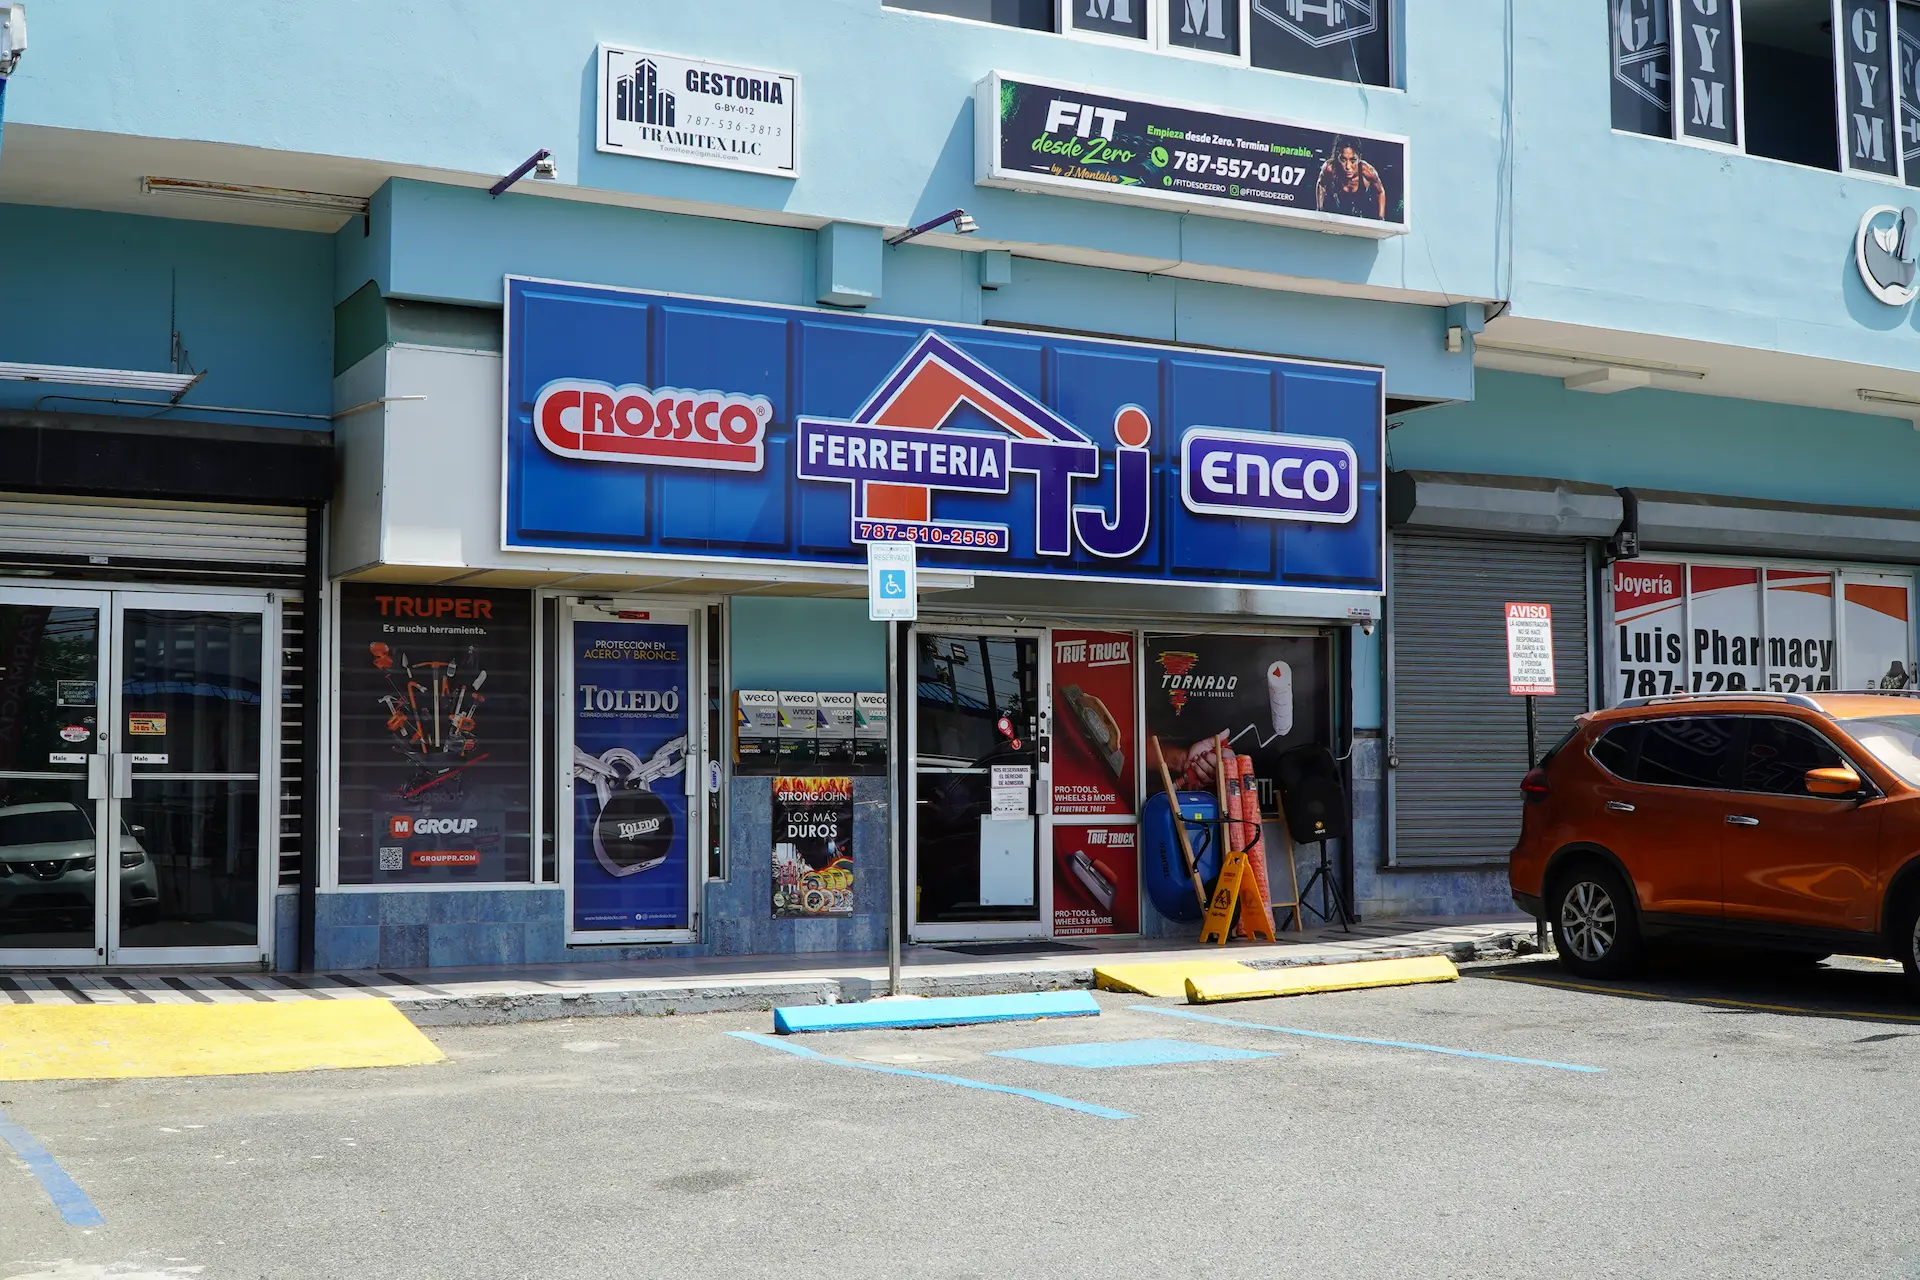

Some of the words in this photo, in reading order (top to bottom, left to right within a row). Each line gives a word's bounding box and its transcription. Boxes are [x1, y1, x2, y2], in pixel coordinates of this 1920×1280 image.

[685, 69, 783, 104] GESTORIA
[714, 102, 755, 116] G-BY-012
[686, 114, 782, 137] 787-536-3813
[1044, 99, 1127, 142] FIT
[638, 126, 728, 152] TRAMITEX
[731, 139, 762, 156] LLC
[1032, 132, 1084, 158] desde
[1080, 138, 1137, 164] Zero
[1147, 125, 1184, 140] Empieza
[1185, 130, 1211, 144] desde
[1212, 135, 1235, 147] Zero.
[1236, 138, 1270, 152] Termina
[1270, 143, 1314, 158] Imparable.
[1050, 164, 1062, 176] by
[1173, 150, 1306, 186] 787-557-0107
[1240, 187, 1294, 202] @FITDESDEZERO
[542, 390, 758, 450] CROSSCO
[808, 433, 1000, 479] FERRETERIA
[1200, 450, 1340, 502] ENCO
[860, 524, 999, 546] 787-510-2559
[1614, 572, 1673, 597] Joyería
[375, 596, 493, 619] TRUPER
[1509, 605, 1547, 618] AVISO
[383, 624, 394, 633] Es
[397, 625, 427, 634] mucha
[430, 625, 487, 635] herramienta.
[654, 642, 666, 650] EN
[1054, 640, 1087, 664] TRUE
[1088, 641, 1132, 667] TRUCK
[1620, 626, 1681, 664] Luis
[1694, 628, 1833, 672] Pharmacy
[584, 649, 621, 660] ACERO
[624, 650, 630, 660] Y
[1160, 674, 1238, 690] TORNADO
[580, 684, 679, 712] TOLEDO
[744, 694, 775, 702] weco
[784, 694, 814, 704] weco
[822, 695, 852, 704] weco
[792, 708, 816, 716] W1000
[778, 791, 848, 802] STRONGJOHN
[1054, 785, 1100, 795] PRO-TOOLS,
[1054, 794, 1086, 802] WHEELS
[1086, 794, 1092, 802] &
[1093, 794, 1116, 802] MORE
[787, 812, 810, 823] LOS
[812, 809, 838, 823] MÁS
[394, 820, 409, 833] M
[413, 818, 478, 835] GROUP
[617, 817, 660, 836] TOLEDO
[787, 824, 838, 838] DUROS
[1086, 829, 1108, 845] TRUE
[1106, 832, 1135, 848] TRUCK
[1054, 910, 1097, 918] PRO-TOOLS,
[1054, 917, 1086, 926] WHEELS
[1091, 916, 1113, 924] MORE
